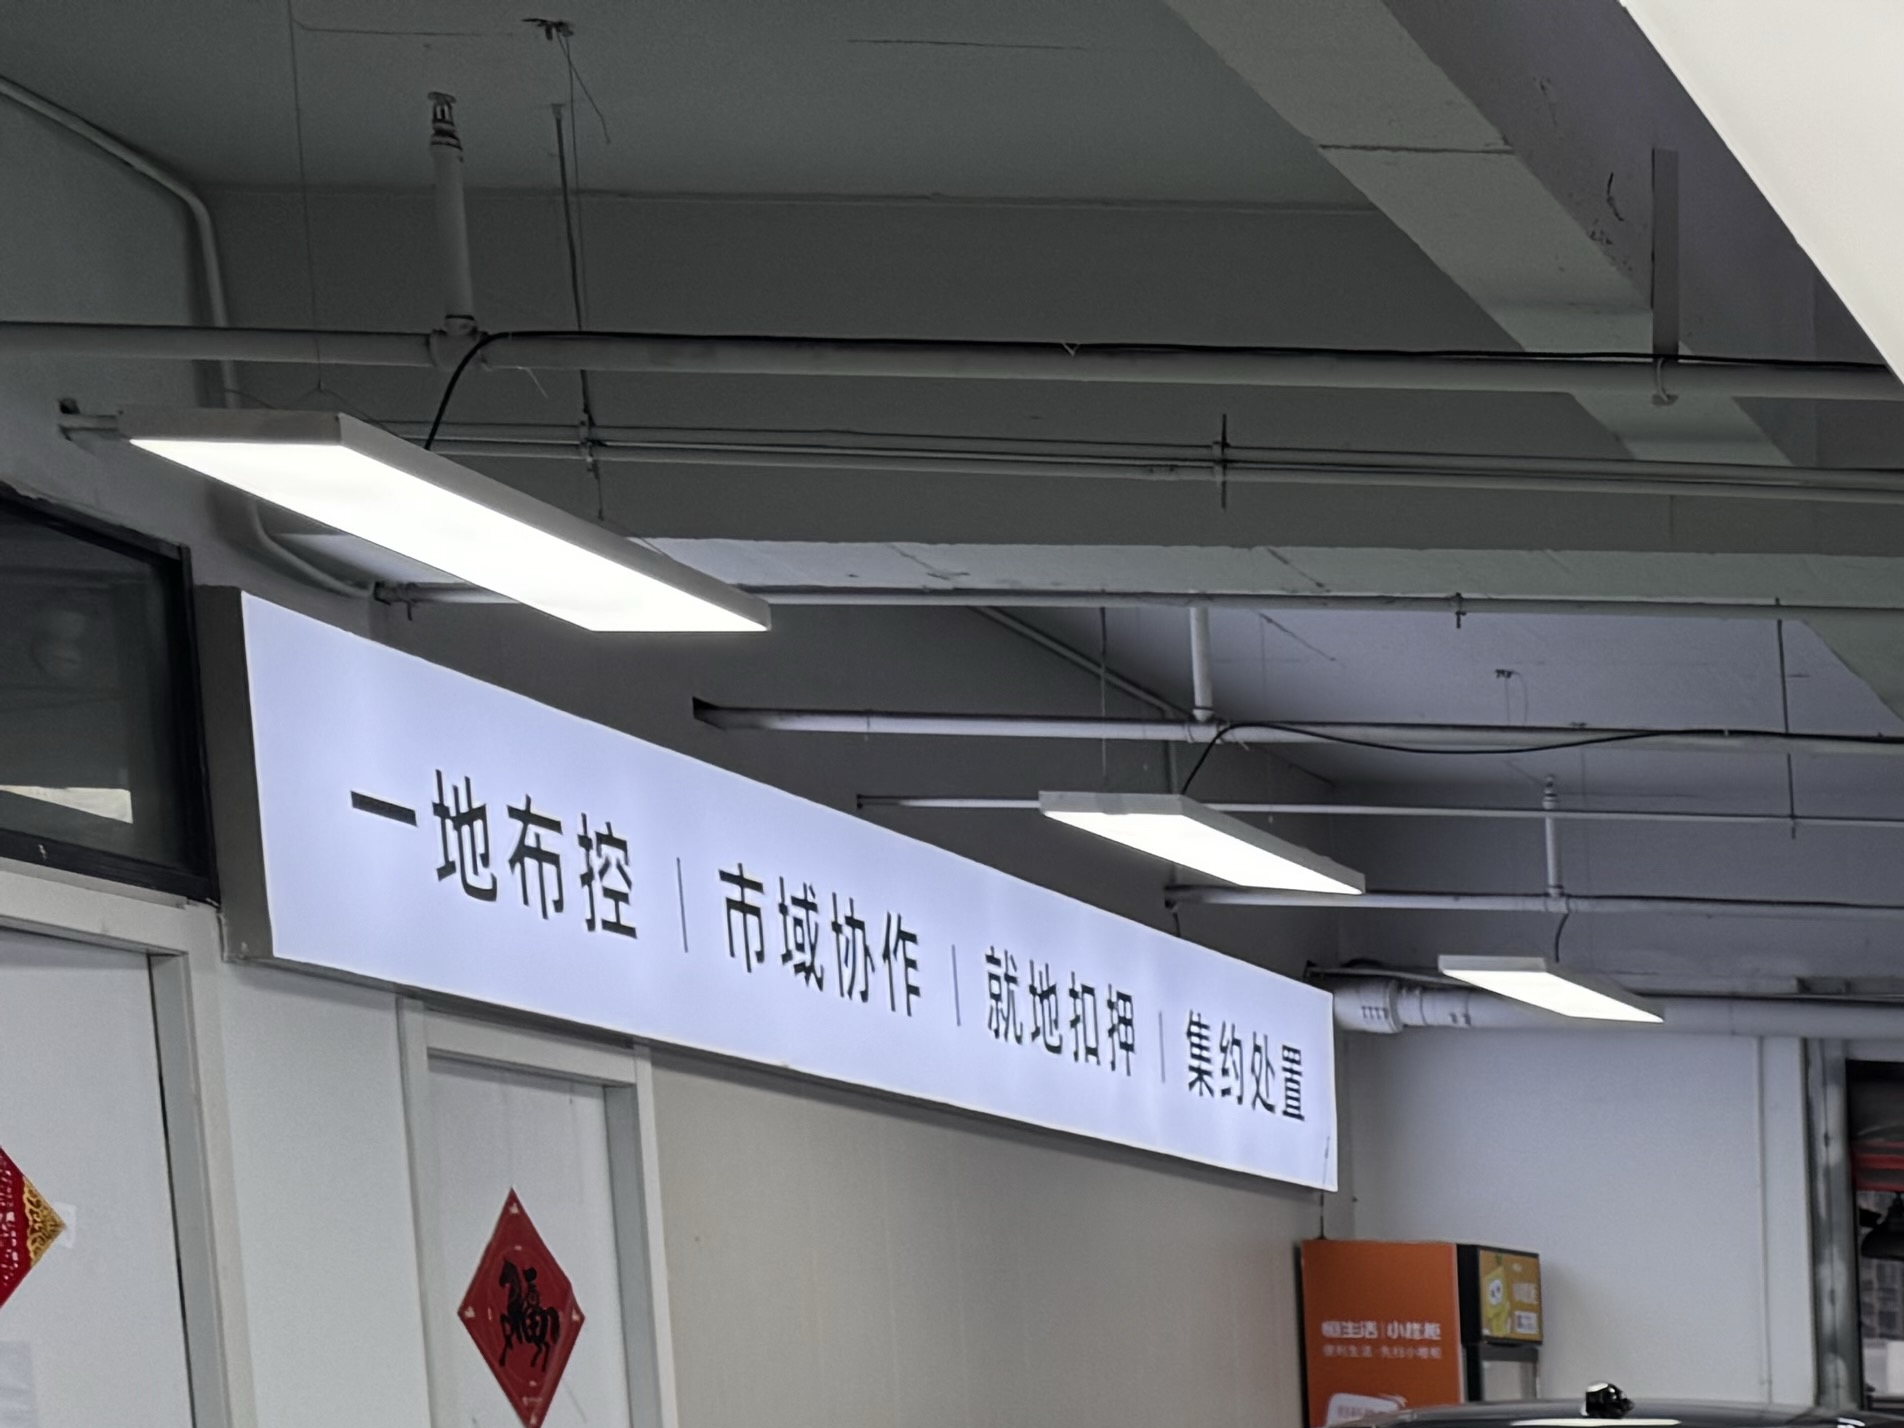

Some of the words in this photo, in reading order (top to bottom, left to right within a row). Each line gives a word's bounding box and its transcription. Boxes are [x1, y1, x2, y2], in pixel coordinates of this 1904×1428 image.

[349, 768, 638, 940] 一地布控
[718, 862, 922, 1017] 市域协作
[984, 945, 1135, 1077] 就地扣押
[1186, 1009, 1305, 1121] 集约处置
